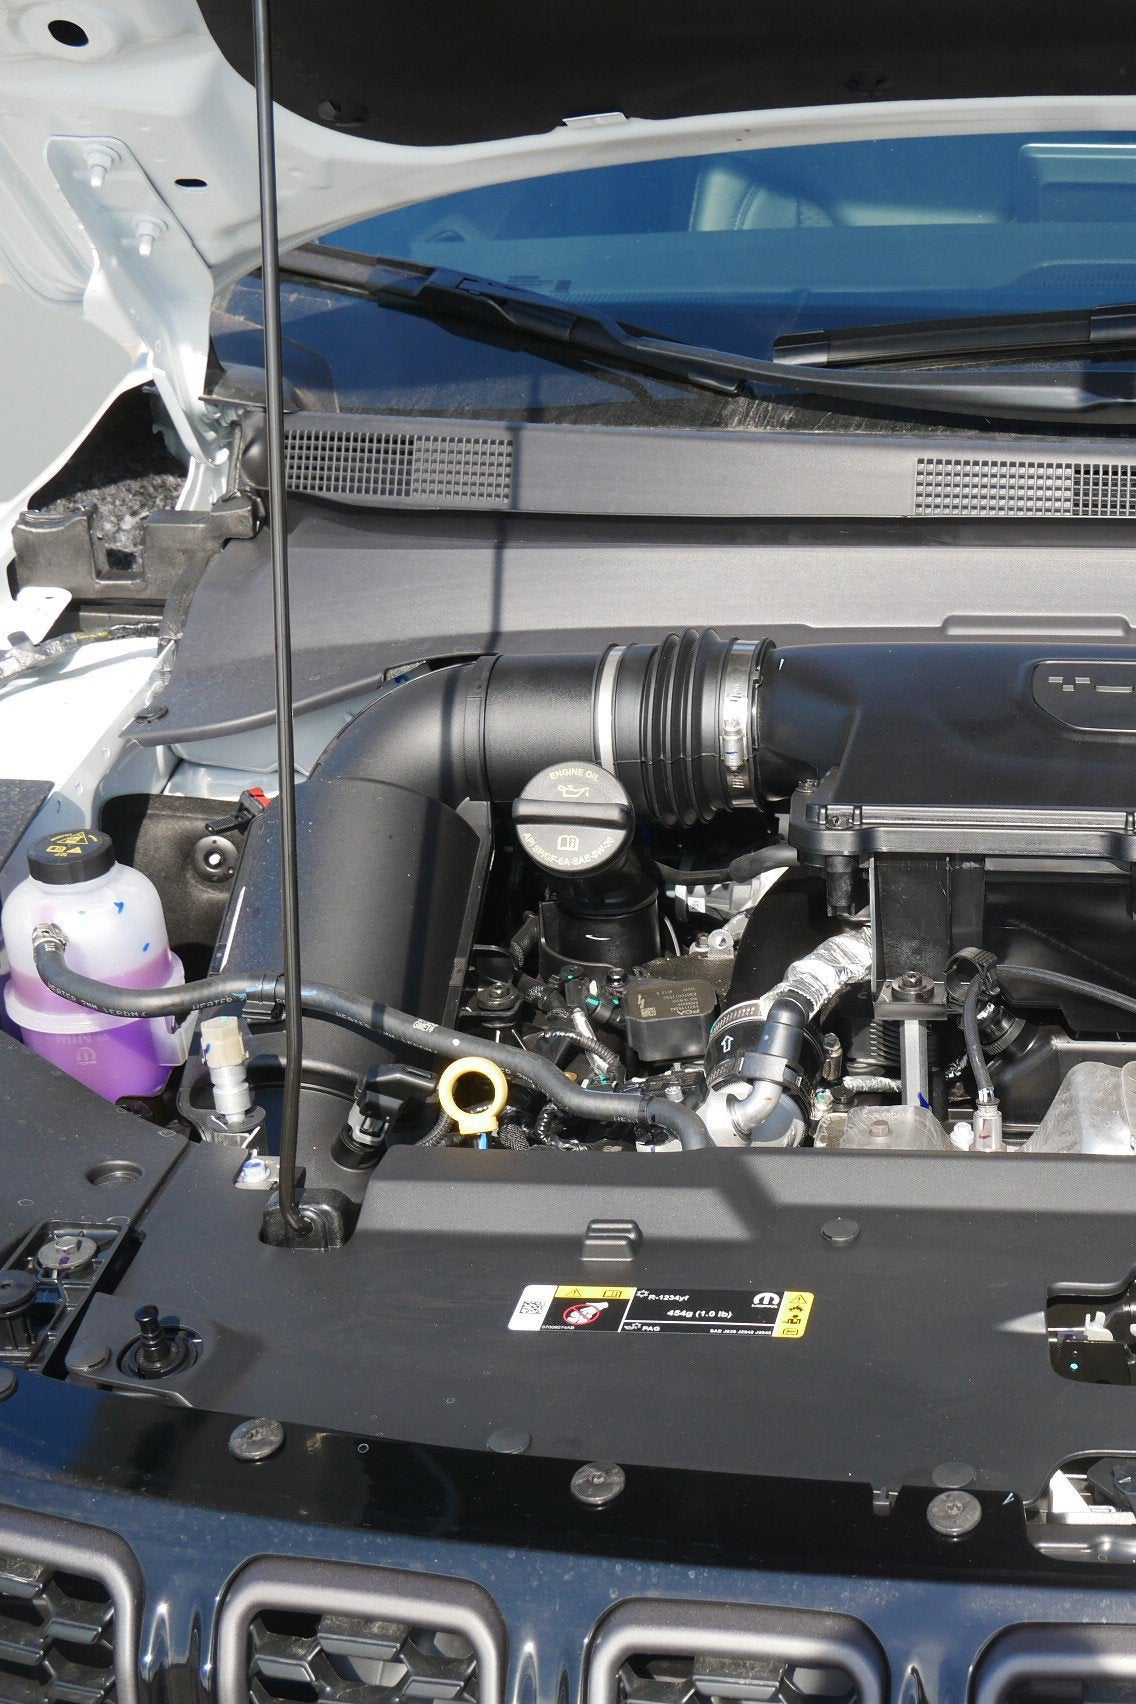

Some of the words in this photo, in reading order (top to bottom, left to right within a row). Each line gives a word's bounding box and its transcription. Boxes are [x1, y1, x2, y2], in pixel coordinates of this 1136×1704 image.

[548, 767, 585, 782] ENGINE
[585, 770, 601, 783] OIL
[648, 1293, 690, 1302] R-1234yf
[666, 1309, 694, 1319] 454g
[695, 1309, 716, 1319] (1.0
[717, 1309, 734, 1319] lb)
